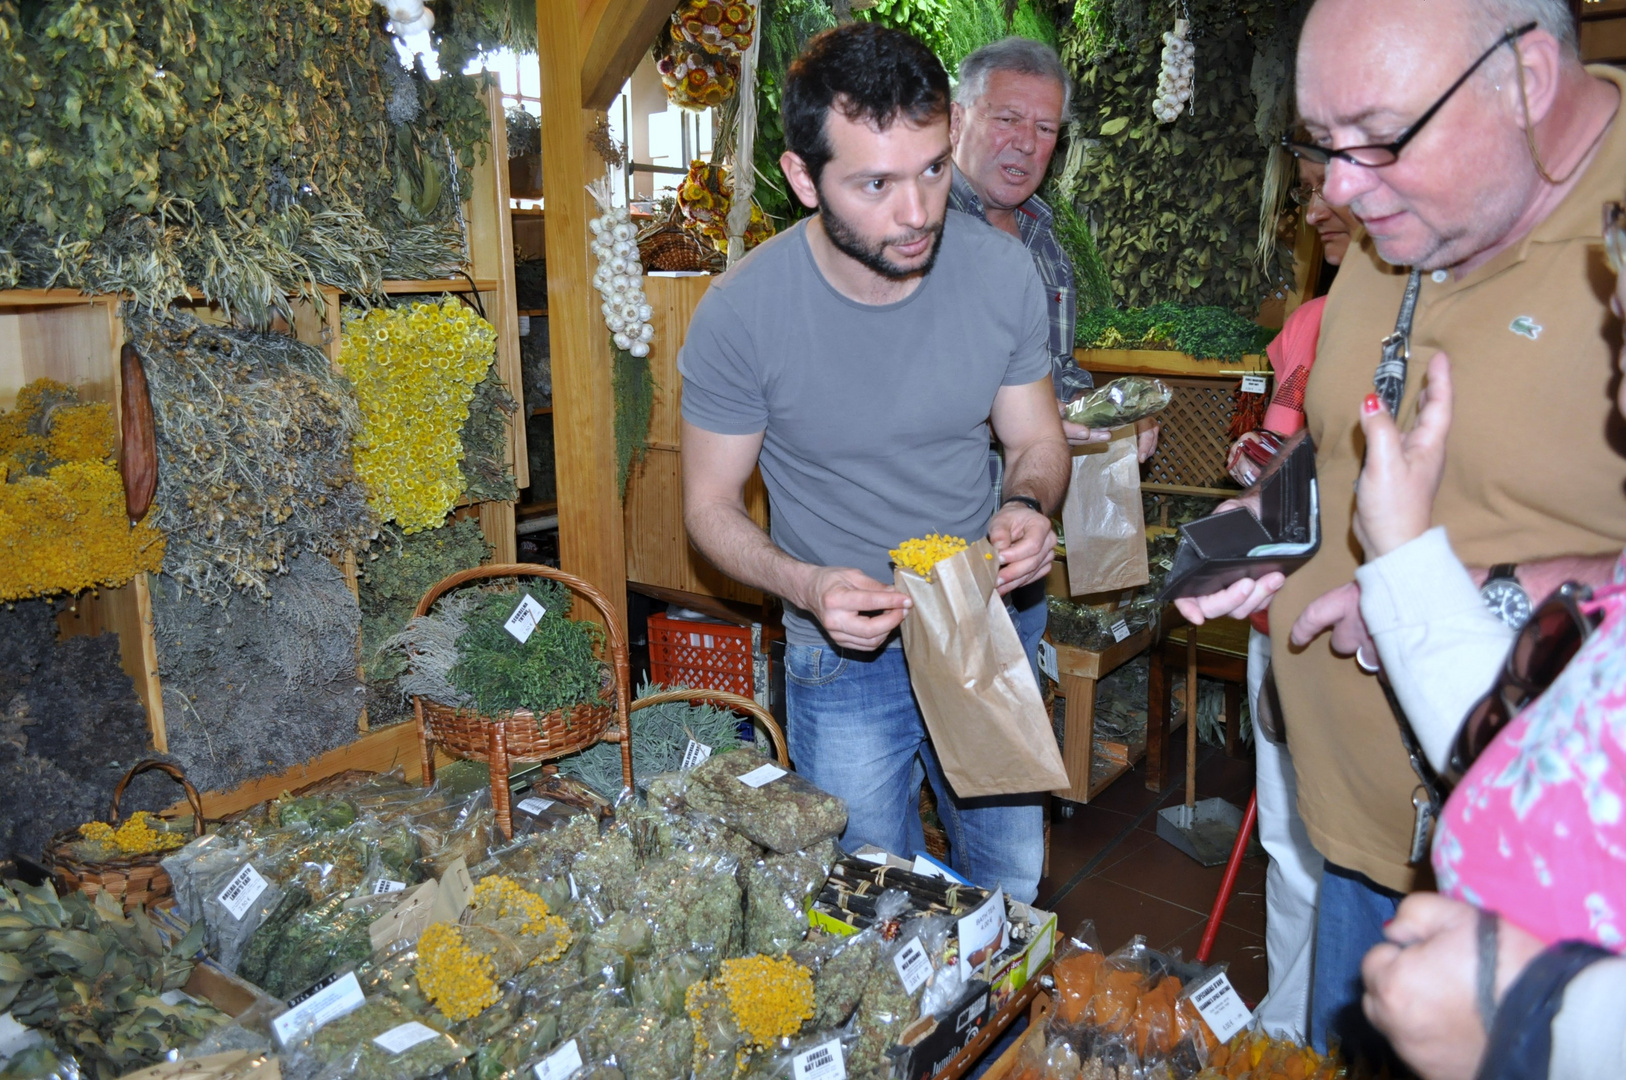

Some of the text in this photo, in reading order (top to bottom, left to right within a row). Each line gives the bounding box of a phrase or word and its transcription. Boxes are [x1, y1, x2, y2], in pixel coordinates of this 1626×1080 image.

[519, 610, 529, 622] THYME
[222, 884, 236, 900] ORELHA
[240, 867, 251, 880] GATO
[1195, 985, 1215, 1002] ESPECIARIAS
[815, 1054, 834, 1068] LAUREL
